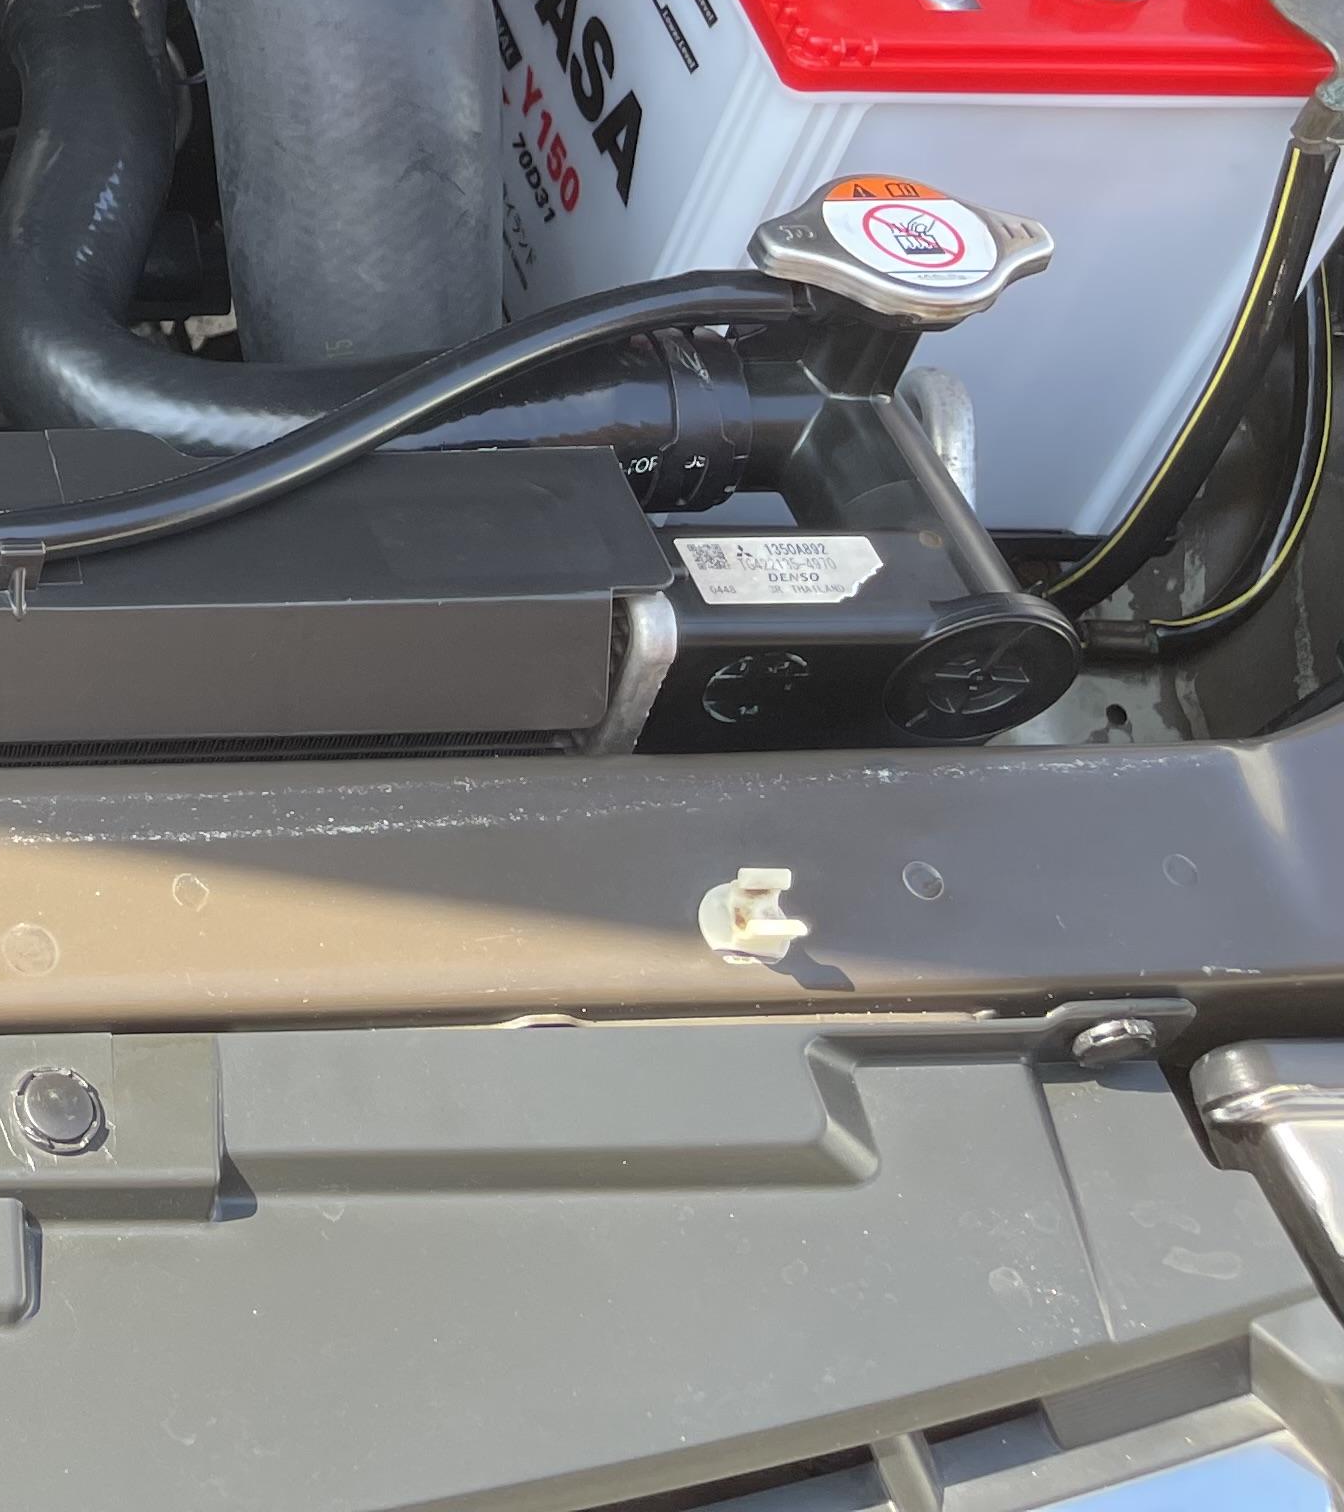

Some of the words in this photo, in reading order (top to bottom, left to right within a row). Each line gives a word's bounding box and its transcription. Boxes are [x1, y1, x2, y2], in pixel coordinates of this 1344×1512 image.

[677, 40, 697, 69] Level
[520, 64, 580, 214] Y150
[512, 132, 557, 225] 70D31
[764, 543, 829, 556] 1350A892
[768, 571, 821, 583] DENSO
[792, 583, 847, 595] THAILAND
